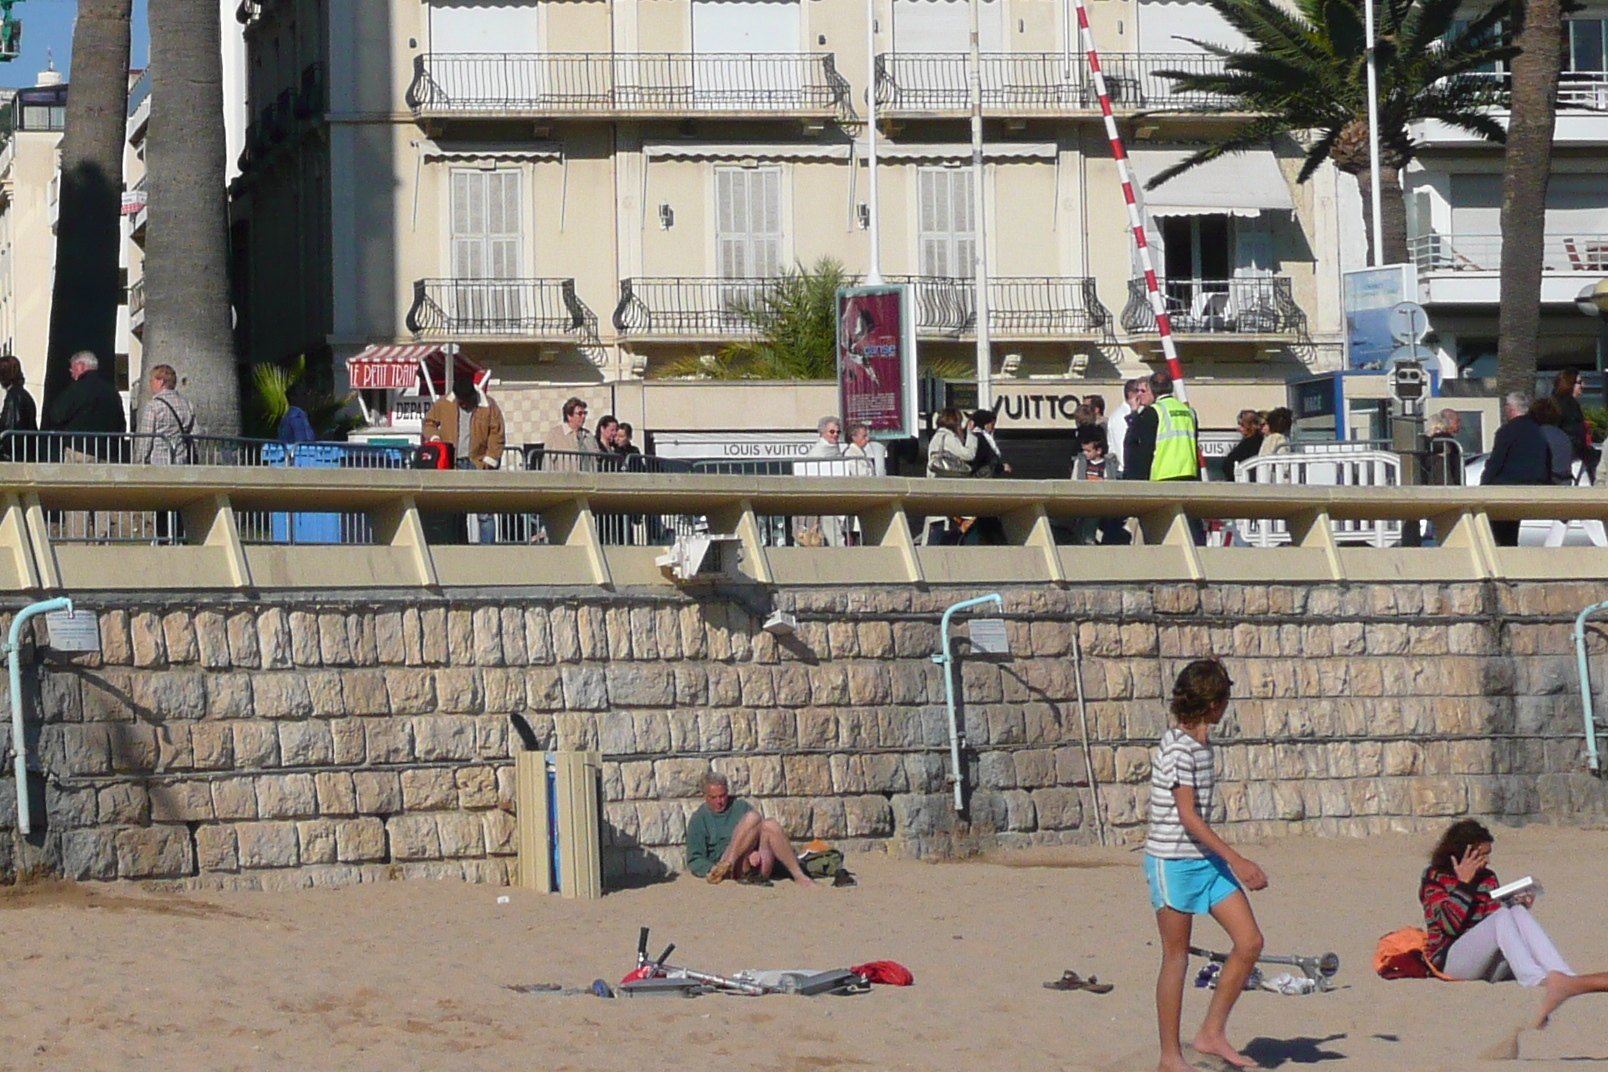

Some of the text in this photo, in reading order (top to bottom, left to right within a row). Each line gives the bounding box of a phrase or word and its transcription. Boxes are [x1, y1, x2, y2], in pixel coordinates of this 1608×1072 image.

[349, 365, 359, 387] LE
[363, 364, 388, 387] PETIT
[396, 402, 431, 420] DEPAR
[723, 444, 813, 456] LOUIS VUITTO
